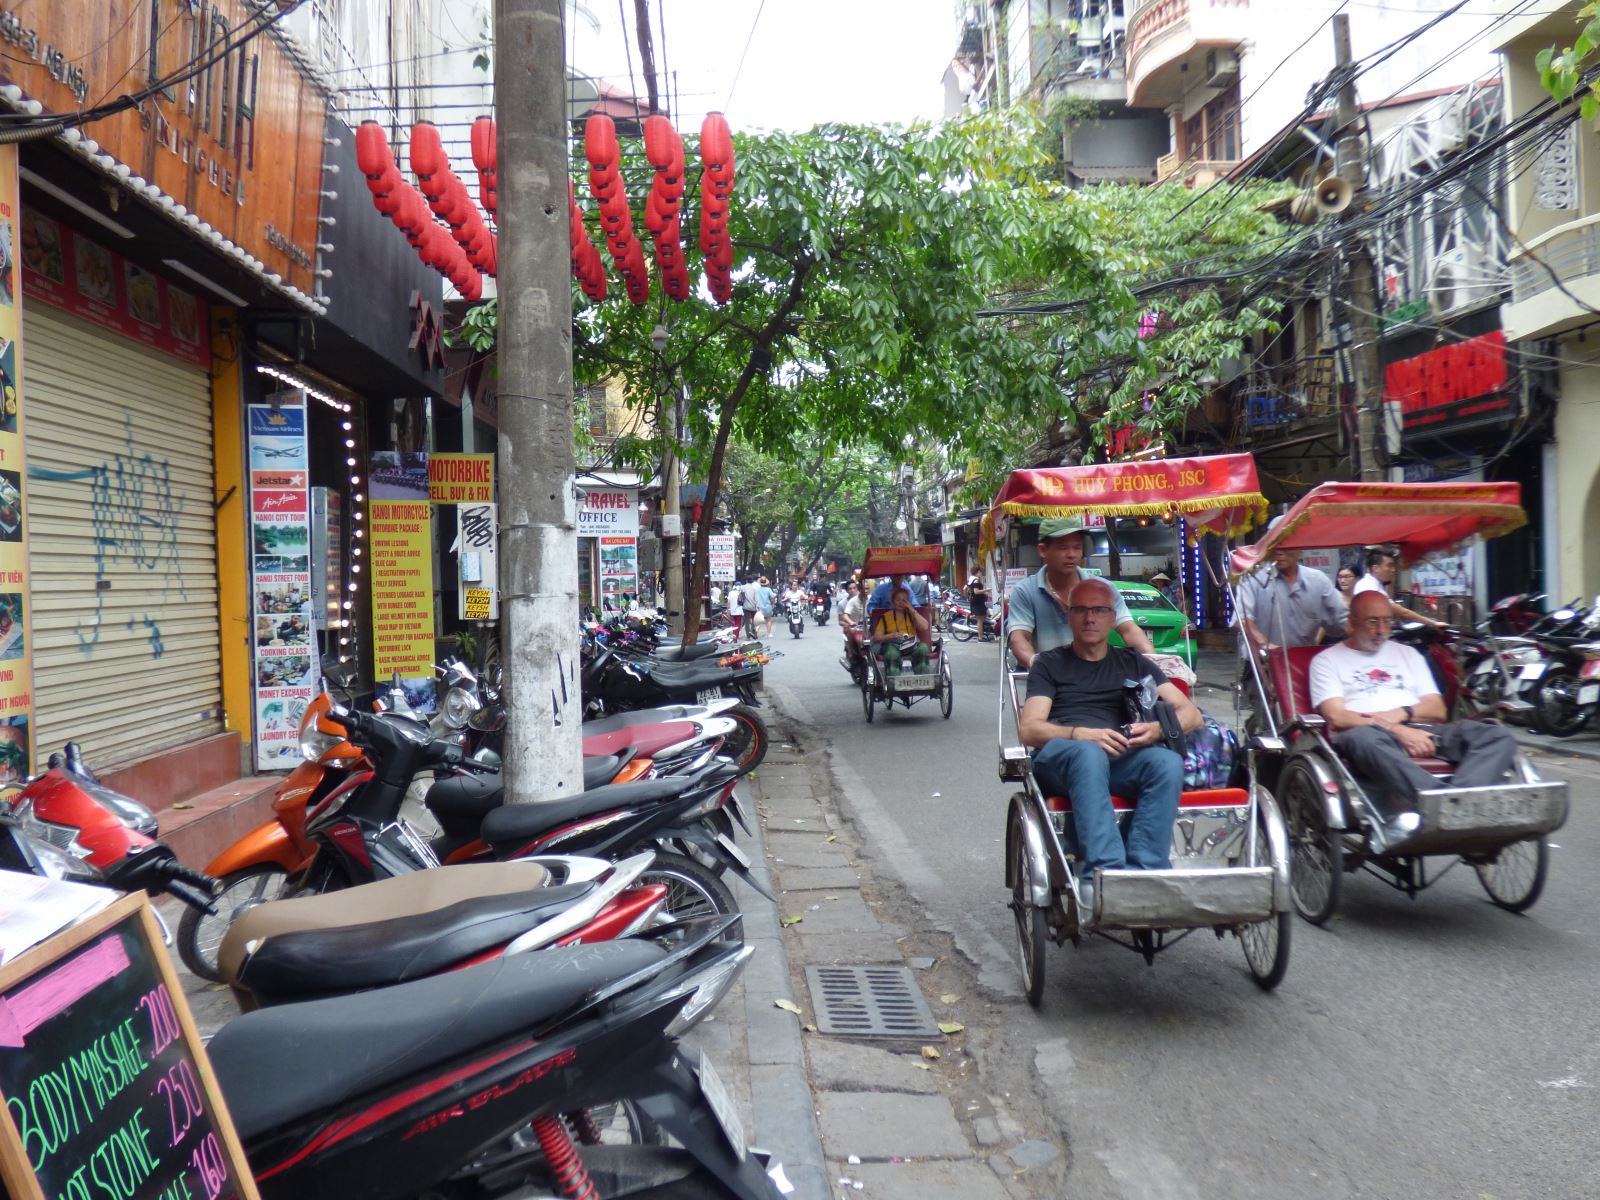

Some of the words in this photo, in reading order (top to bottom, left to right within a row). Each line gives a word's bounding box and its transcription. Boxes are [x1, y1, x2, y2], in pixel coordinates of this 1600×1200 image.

[429, 460, 490, 482] MOTORBIKE
[256, 475, 292, 485] Jetstar
[1073, 477, 1107, 493] HUY
[1178, 469, 1205, 487] JSC
[450, 486, 465, 499] BUY
[468, 486, 474, 499] &
[477, 486, 489, 499] FIX
[584, 493, 630, 509] TRAVEL
[255, 513, 274, 521] HANOI
[275, 513, 288, 521] CITY
[290, 513, 305, 521] TOUR
[372, 505, 389, 520] HANOI
[391, 505, 429, 520] MOTORCYCLE
[578, 512, 618, 522] OFFICE
[400, 524, 419, 532] PACKAGE
[274, 574, 293, 582] STREET
[295, 574, 308, 582] FOOD
[261, 648, 287, 656] COOKING
[288, 647, 308, 656] CLASS
[259, 689, 279, 699] MONEY
[281, 687, 312, 698] EXCHANGE
[260, 732, 286, 742] LAUNDRY
[7, 1061, 79, 1172] BODY
[70, 1017, 150, 1123] MASSAGE
[157, 1058, 203, 1148] 250
[90, 1107, 161, 1200] STONE
[192, 1131, 227, 1200] 160
